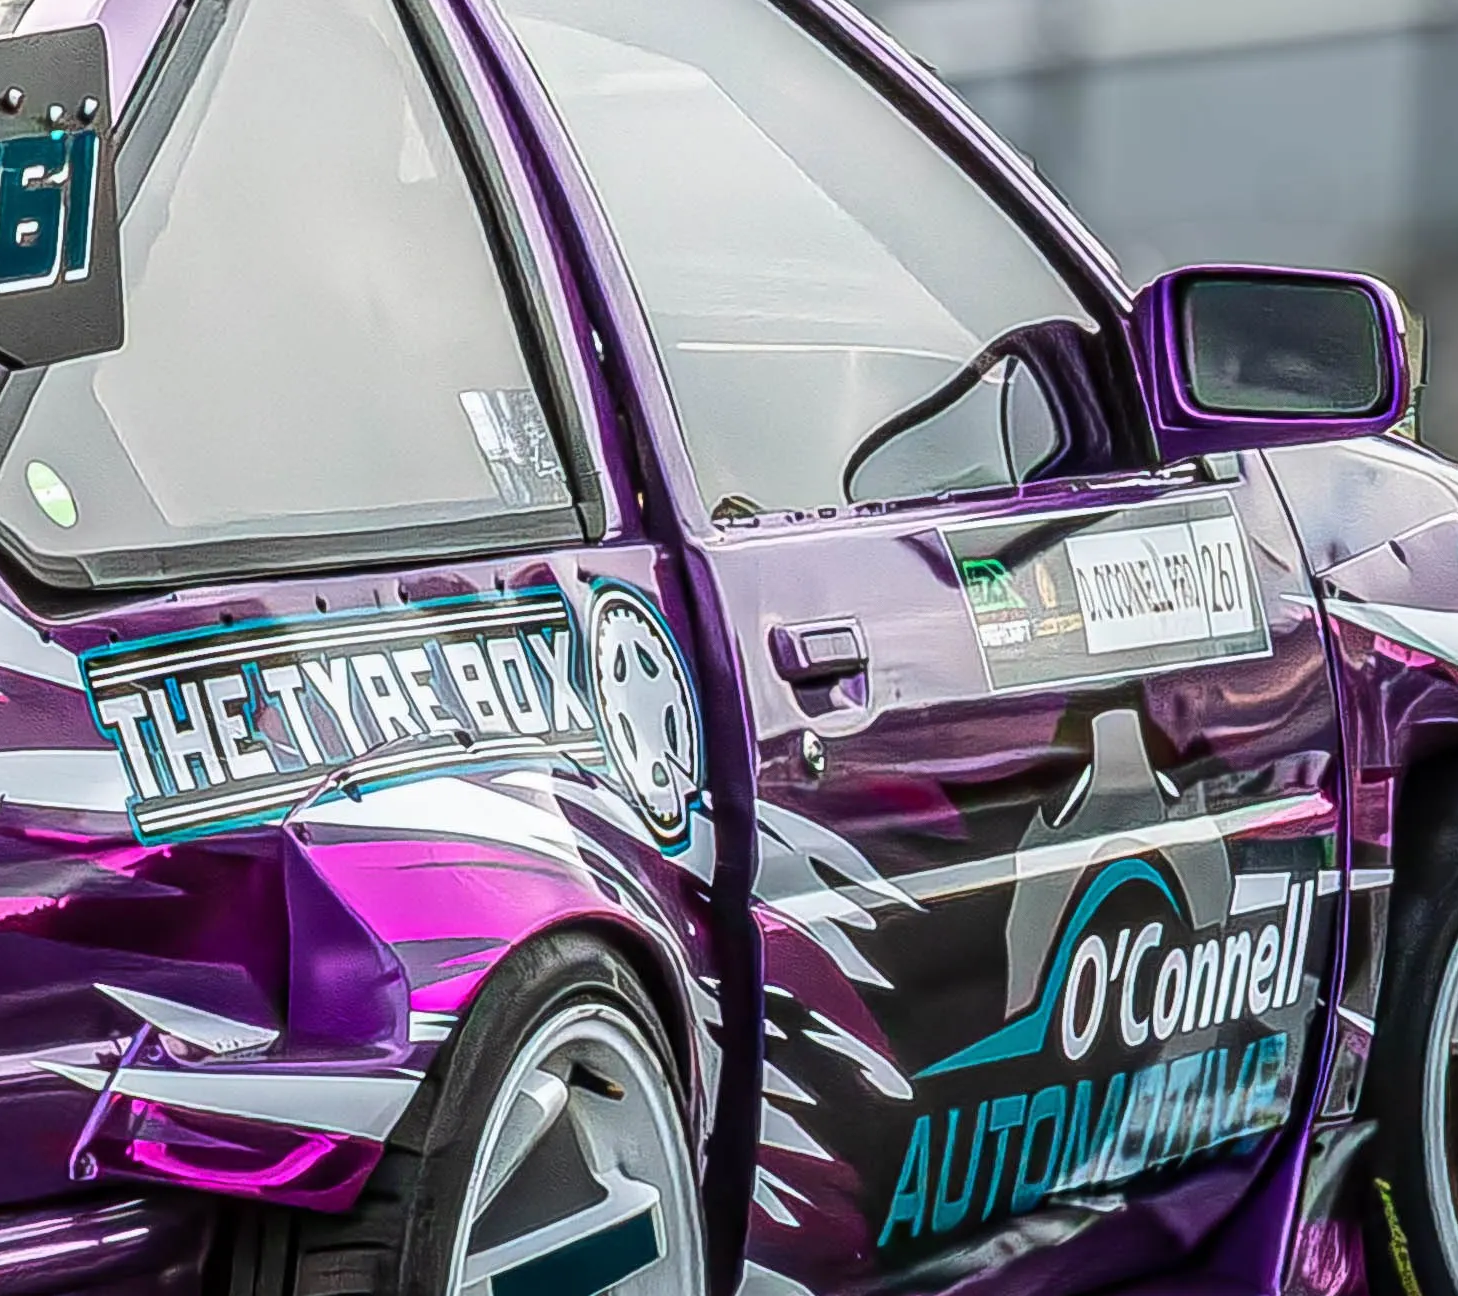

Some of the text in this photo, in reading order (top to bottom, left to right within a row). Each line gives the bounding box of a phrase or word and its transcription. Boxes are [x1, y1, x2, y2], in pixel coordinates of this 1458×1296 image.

[1201, 541, 1244, 613] 261
[99, 628, 594, 801] THE TYRE BOX
[1061, 878, 1316, 1062] O'Connell
[877, 1032, 1288, 1248] AUTOMOTIVE
